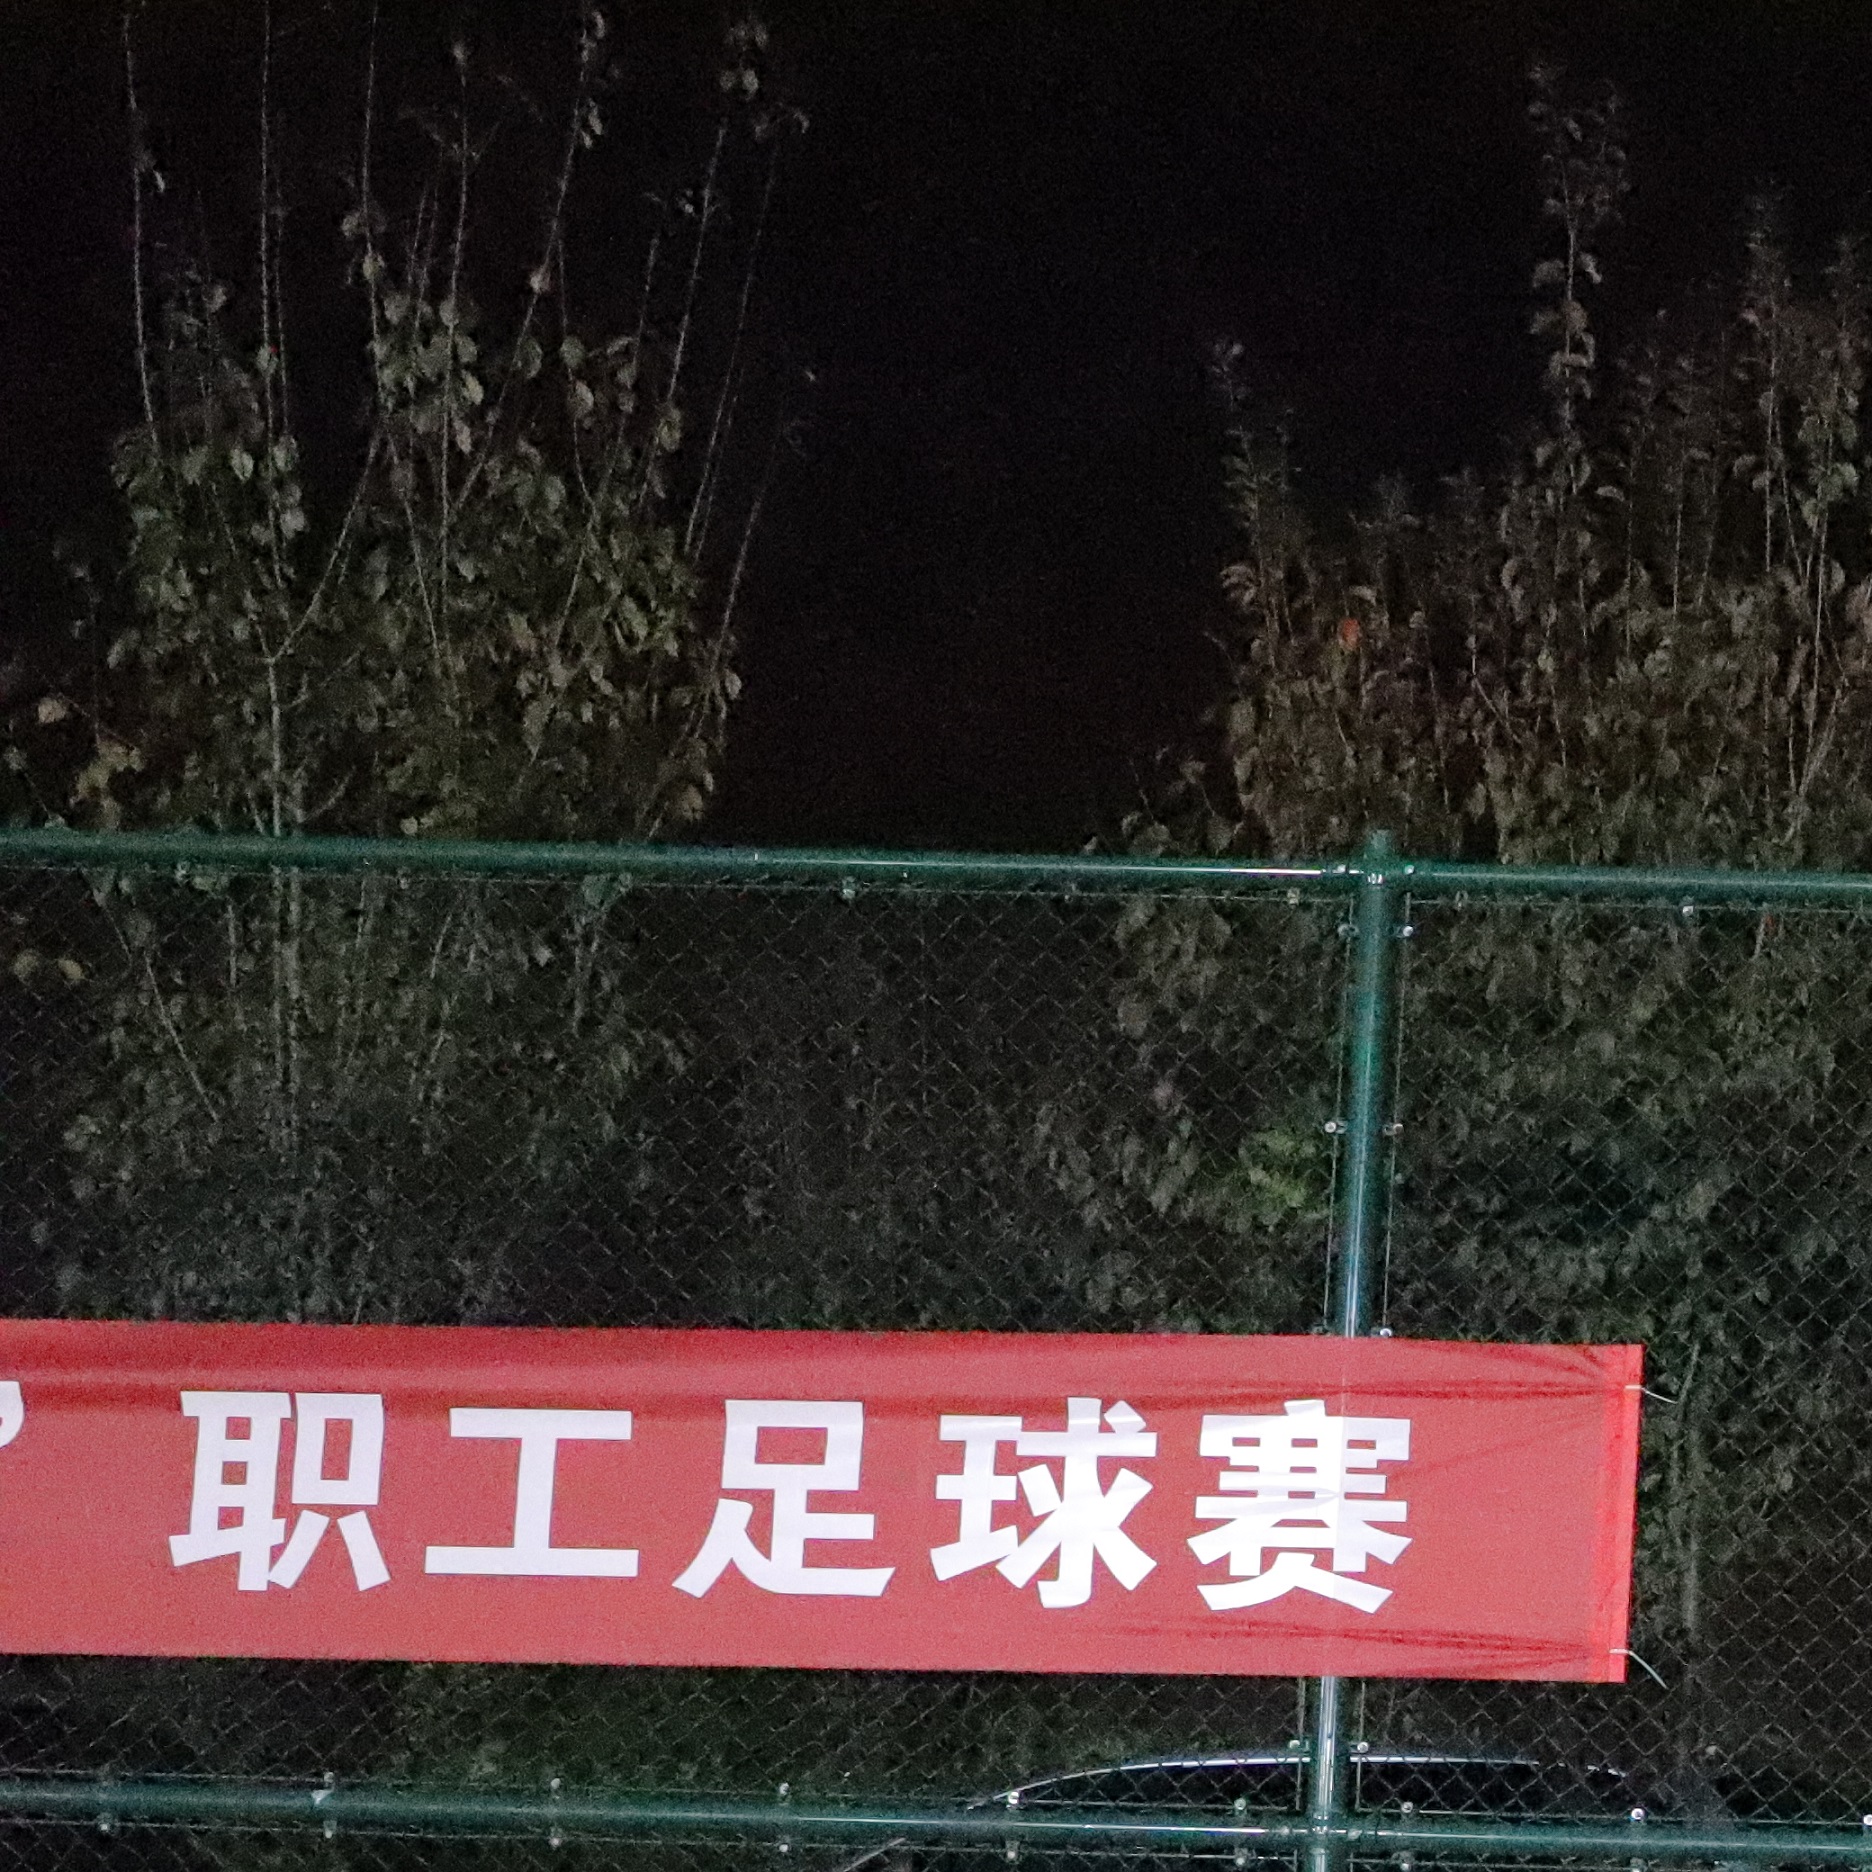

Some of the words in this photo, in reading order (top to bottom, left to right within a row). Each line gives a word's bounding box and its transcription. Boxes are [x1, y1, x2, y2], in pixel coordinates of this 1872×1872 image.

[169, 1390, 1413, 1614] 职工足球赛
